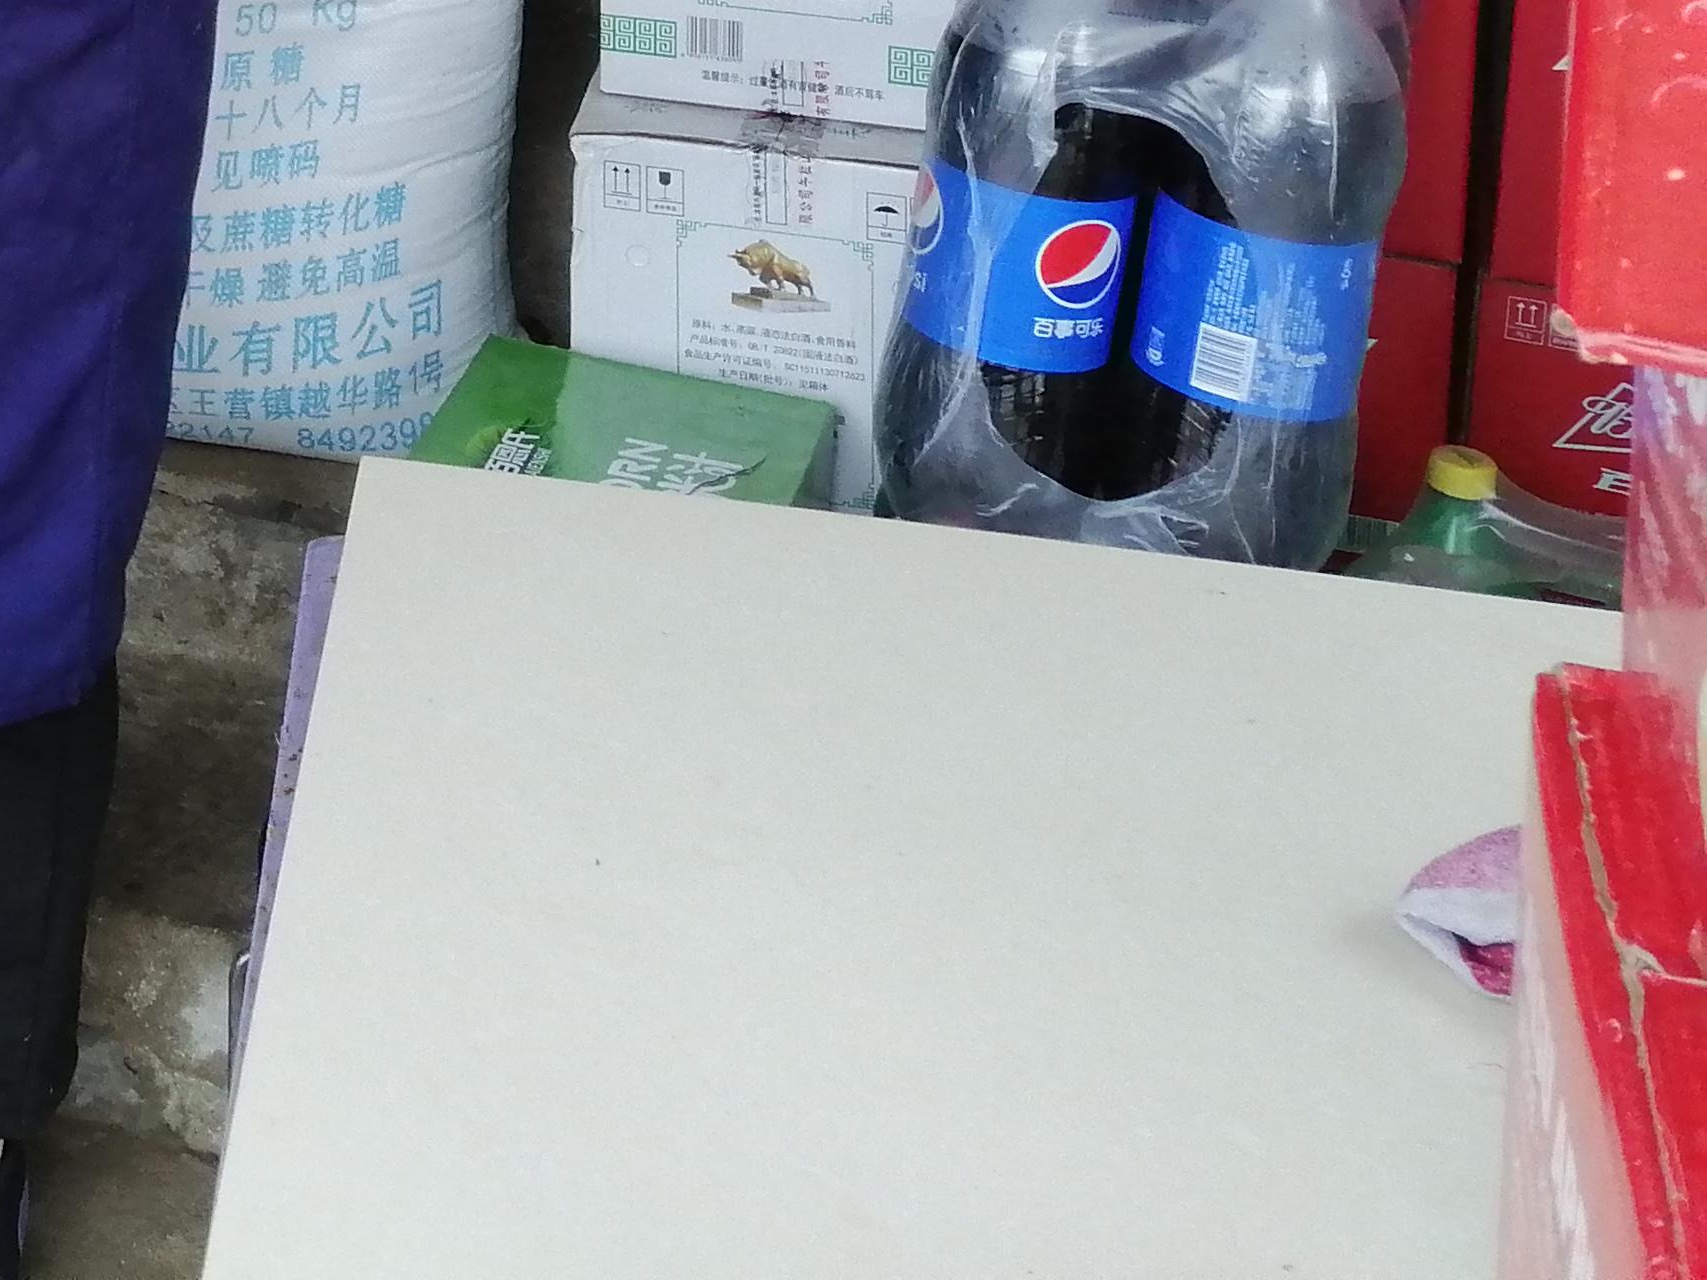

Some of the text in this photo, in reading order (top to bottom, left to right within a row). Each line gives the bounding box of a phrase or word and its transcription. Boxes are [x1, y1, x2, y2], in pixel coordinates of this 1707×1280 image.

[235, 2, 277, 37] 50
[219, 42, 305, 91] 原糖
[215, 83, 362, 142] 十八个月
[211, 138, 321, 192] 见喷码
[191, 181, 408, 254] 及蔗糖转化糖
[256, 237, 402, 303] 避免高温
[175, 279, 444, 378] 业有限公司
[1032, 316, 1105, 340] 百事可乐
